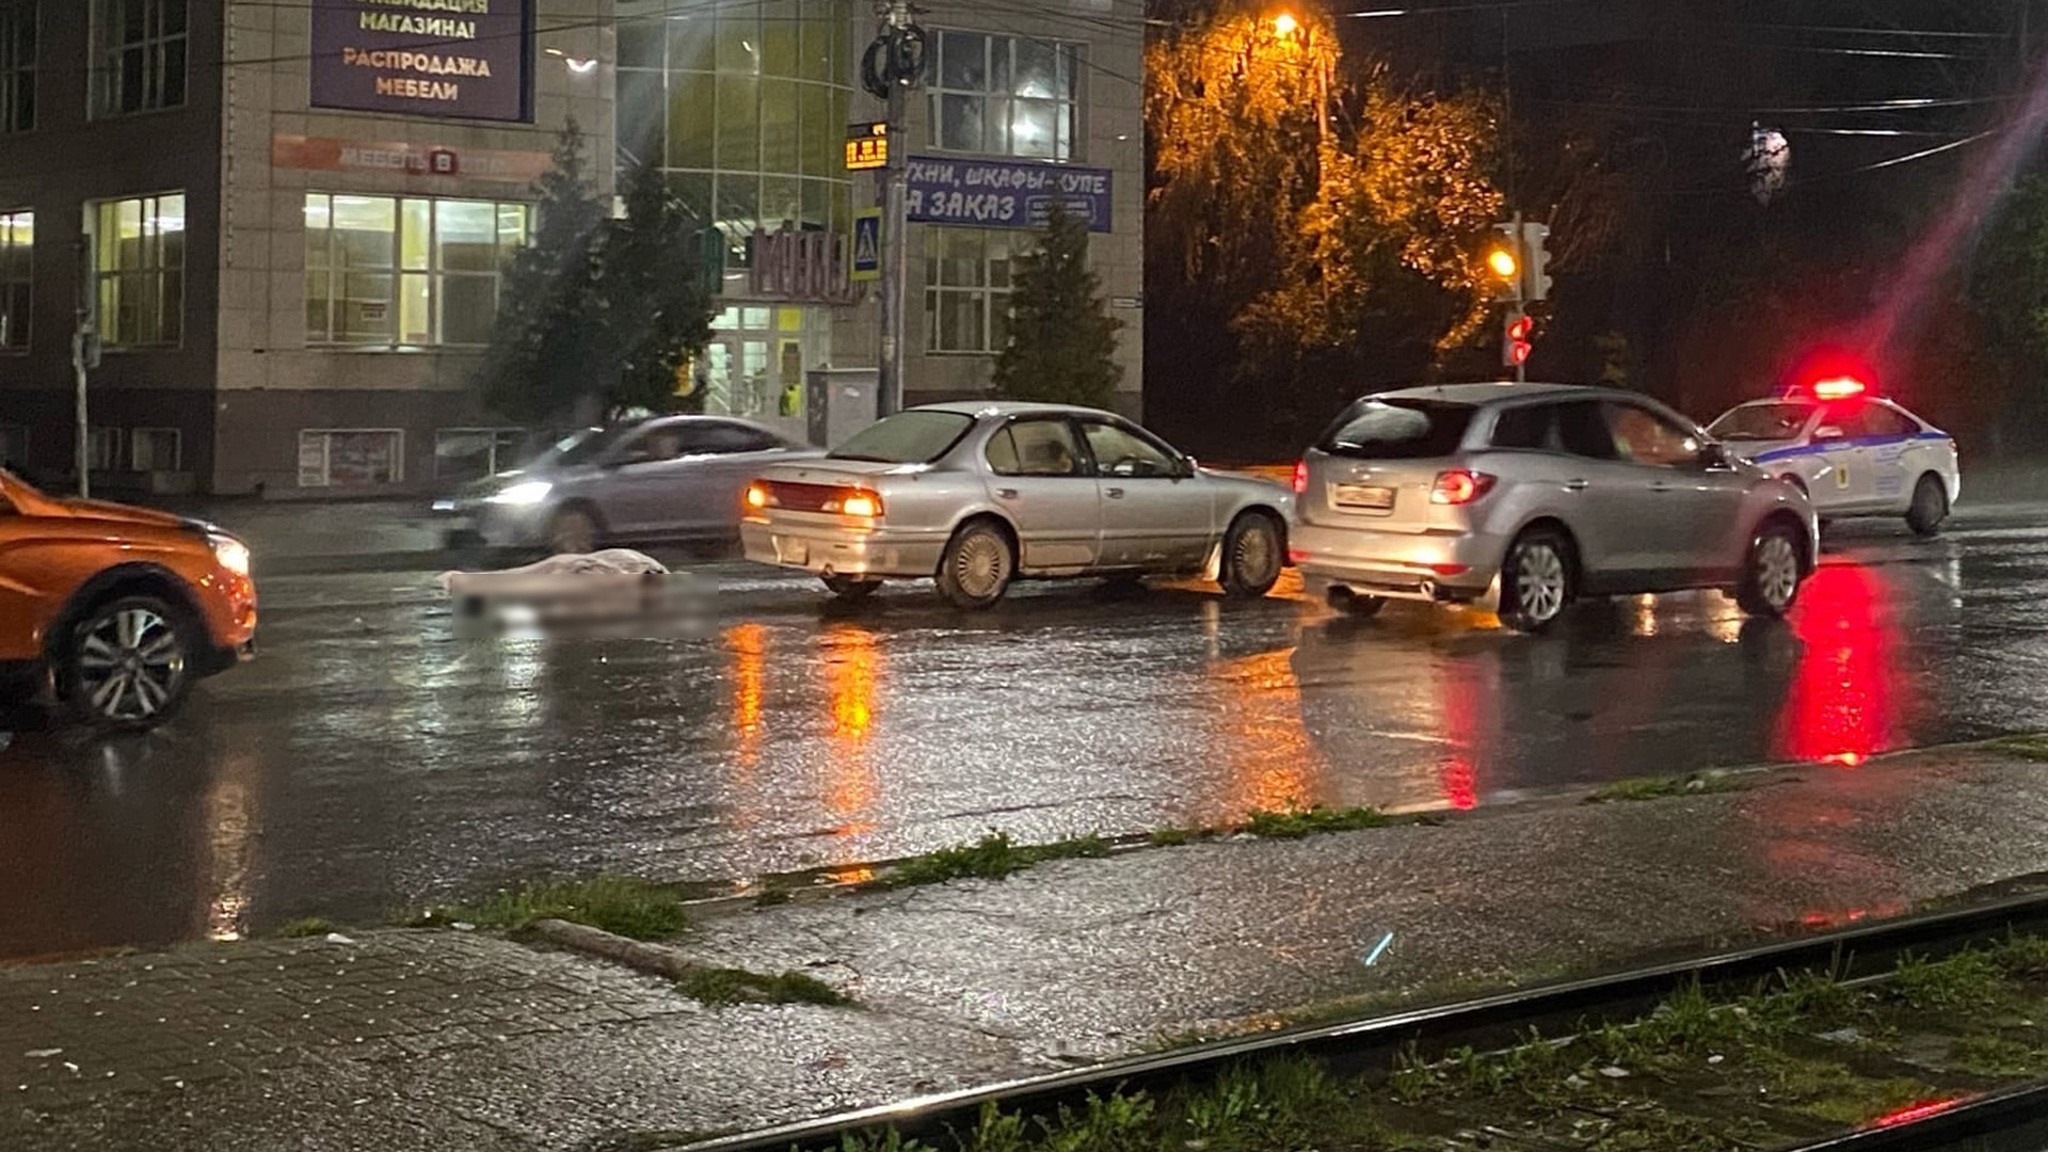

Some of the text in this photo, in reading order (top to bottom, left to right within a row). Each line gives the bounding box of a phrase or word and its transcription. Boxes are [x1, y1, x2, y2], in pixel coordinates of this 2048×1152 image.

[360, 11, 475, 39] МАГАЗИНА!
[342, 47, 491, 77] РАСПРОДАЖА
[375, 76, 458, 101] МЕБЕЛИ
[929, 191, 1015, 221] ЗАКАЗ
